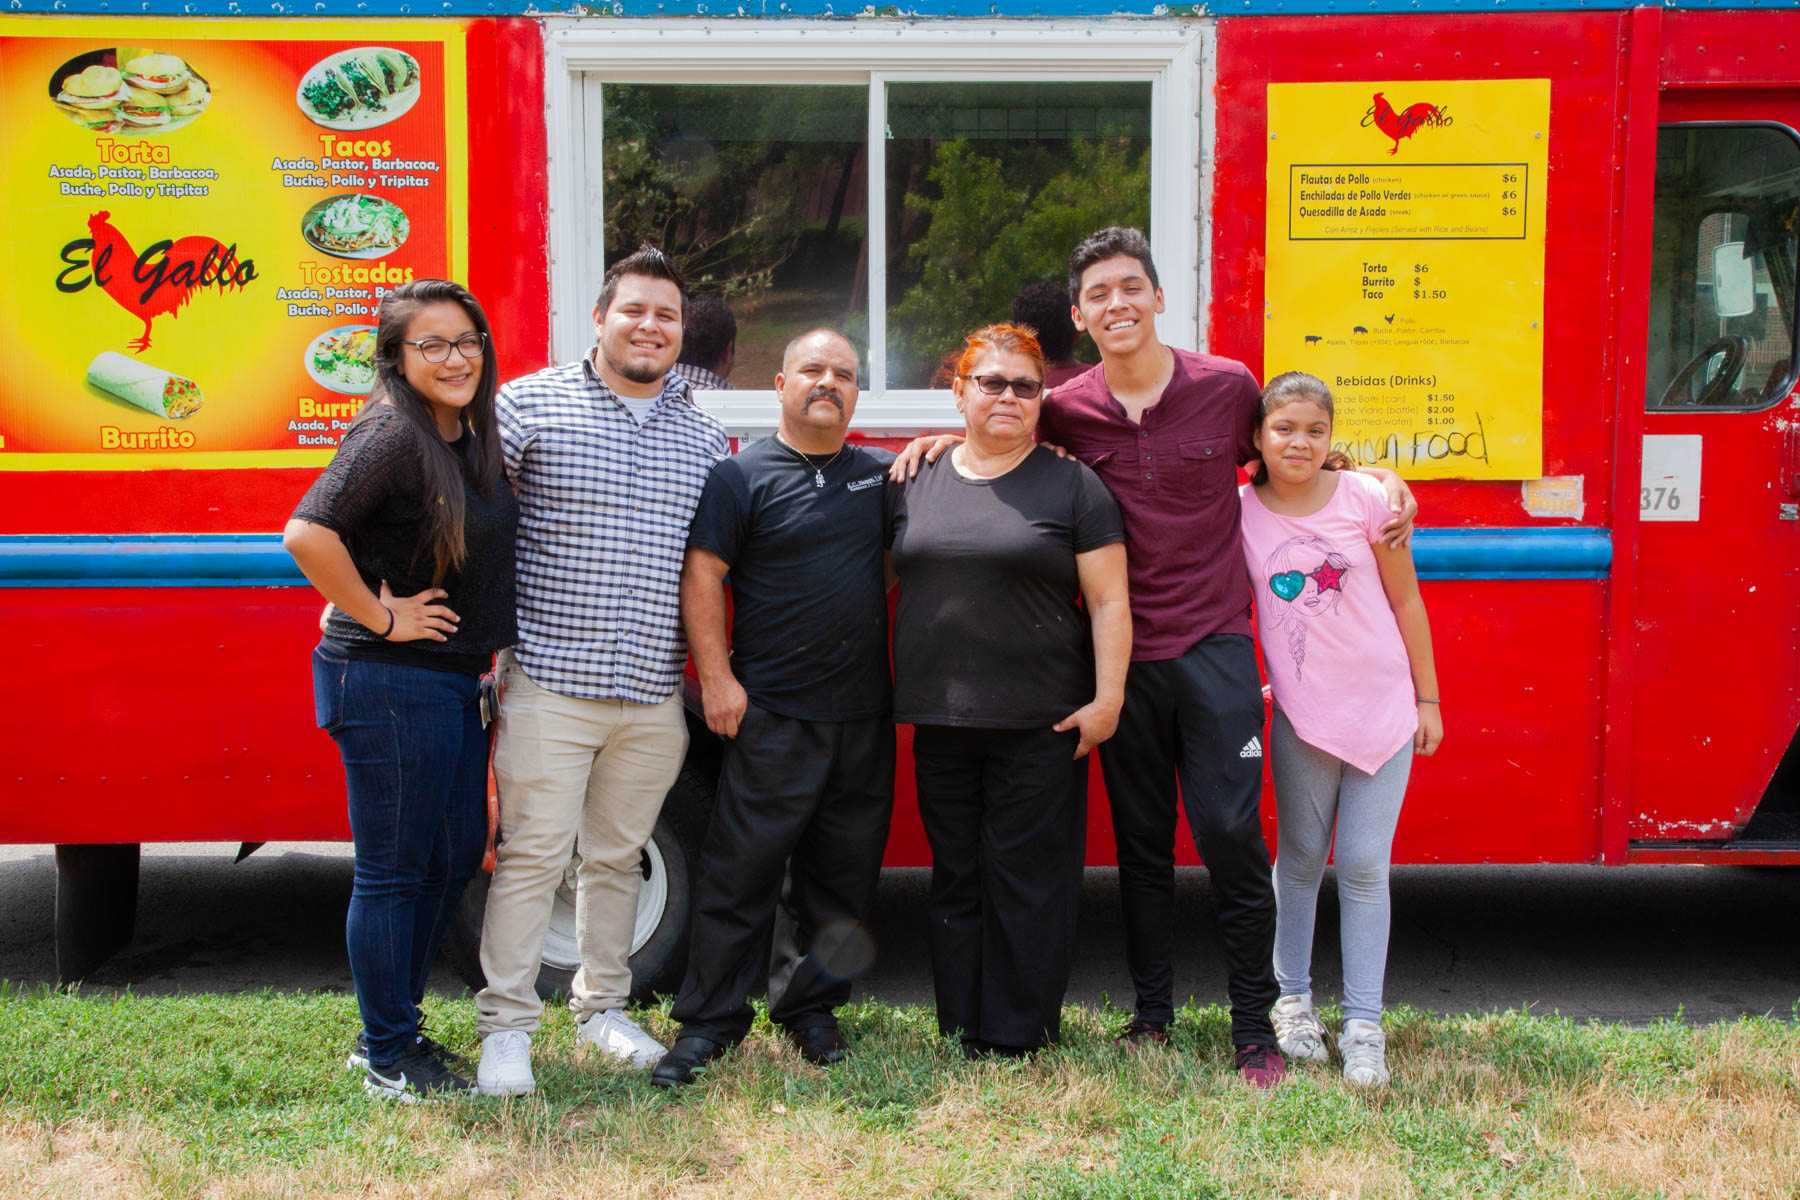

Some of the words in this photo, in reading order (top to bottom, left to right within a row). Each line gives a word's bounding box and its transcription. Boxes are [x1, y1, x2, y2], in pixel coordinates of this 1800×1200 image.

[1360, 104, 1391, 127] El
[1397, 105, 1453, 138] Gallo
[96, 138, 170, 164] Torta
[319, 134, 392, 157] Tacos
[272, 157, 319, 171] Asada,
[321, 157, 369, 171] Pastor,
[372, 157, 440, 172] Barbacoa,
[49, 165, 96, 180] Asada,
[98, 166, 147, 181] Pastor,
[149, 166, 219, 180] Barbacoa,
[1502, 173, 1517, 183] $6
[283, 174, 328, 188] Buche,
[331, 174, 365, 187] Pollo
[367, 177, 377, 189] y
[379, 174, 429, 189] Tripitas
[1300, 174, 1333, 185] Flautas
[1335, 174, 1346, 184] de
[1348, 174, 1370, 184] Pollo
[1372, 176, 1402, 184] (chicken)
[60, 182, 106, 197] Buche,
[108, 183, 143, 196] Pollo
[144, 187, 155, 198] y
[157, 184, 209, 198] Tripitas
[1300, 190, 1345, 200] Enchiladas
[1347, 190, 1358, 200] de
[1360, 190, 1381, 200] Pollo
[1383, 189, 1411, 200] Verdes
[1413, 192, 1441, 200] (chicken
[1502, 190, 1517, 200] $6
[1299, 206, 1344, 218] Quesadilla
[1347, 206, 1357, 216] de
[1360, 206, 1386, 216] Asada
[1502, 206, 1517, 216] $6
[1391, 225, 1417, 234] (Served
[1418, 225, 1432, 233] with
[1433, 225, 1449, 233] Rice
[1450, 225, 1463, 233] and
[1464, 225, 1488, 233] Beans)
[56, 238, 113, 293] El
[133, 239, 259, 305] Gallo
[299, 261, 413, 285] Tostadas
[1362, 262, 1387, 273] Torta
[1414, 264, 1429, 273] $6
[1362, 276, 1395, 287] Burrito
[1413, 277, 1421, 287] $
[276, 287, 322, 300] Asada,
[325, 286, 372, 300] Pastor,
[1362, 289, 1384, 299] Taco
[1413, 289, 1447, 299] $1.50
[288, 303, 332, 317] Buche,
[335, 303, 368, 315] Pollo
[371, 305, 379, 317] y
[1336, 376, 1386, 387] Bebidas
[1389, 375, 1437, 388] (Drinks)
[1382, 394, 1406, 404] (can)
[1427, 393, 1455, 402] $1.50
[299, 397, 364, 418] Burri
[1386, 406, 1419, 416] (bottle)
[1427, 405, 1455, 414] $2.00
[288, 419, 329, 431] Asada,
[1346, 417, 1381, 426] (bottled
[1427, 417, 1455, 425] $1.00
[100, 425, 196, 450] Burrito
[298, 434, 338, 446] Buche,
[1640, 487, 1680, 511] 376
[1240, 750, 1262, 758] adidas
